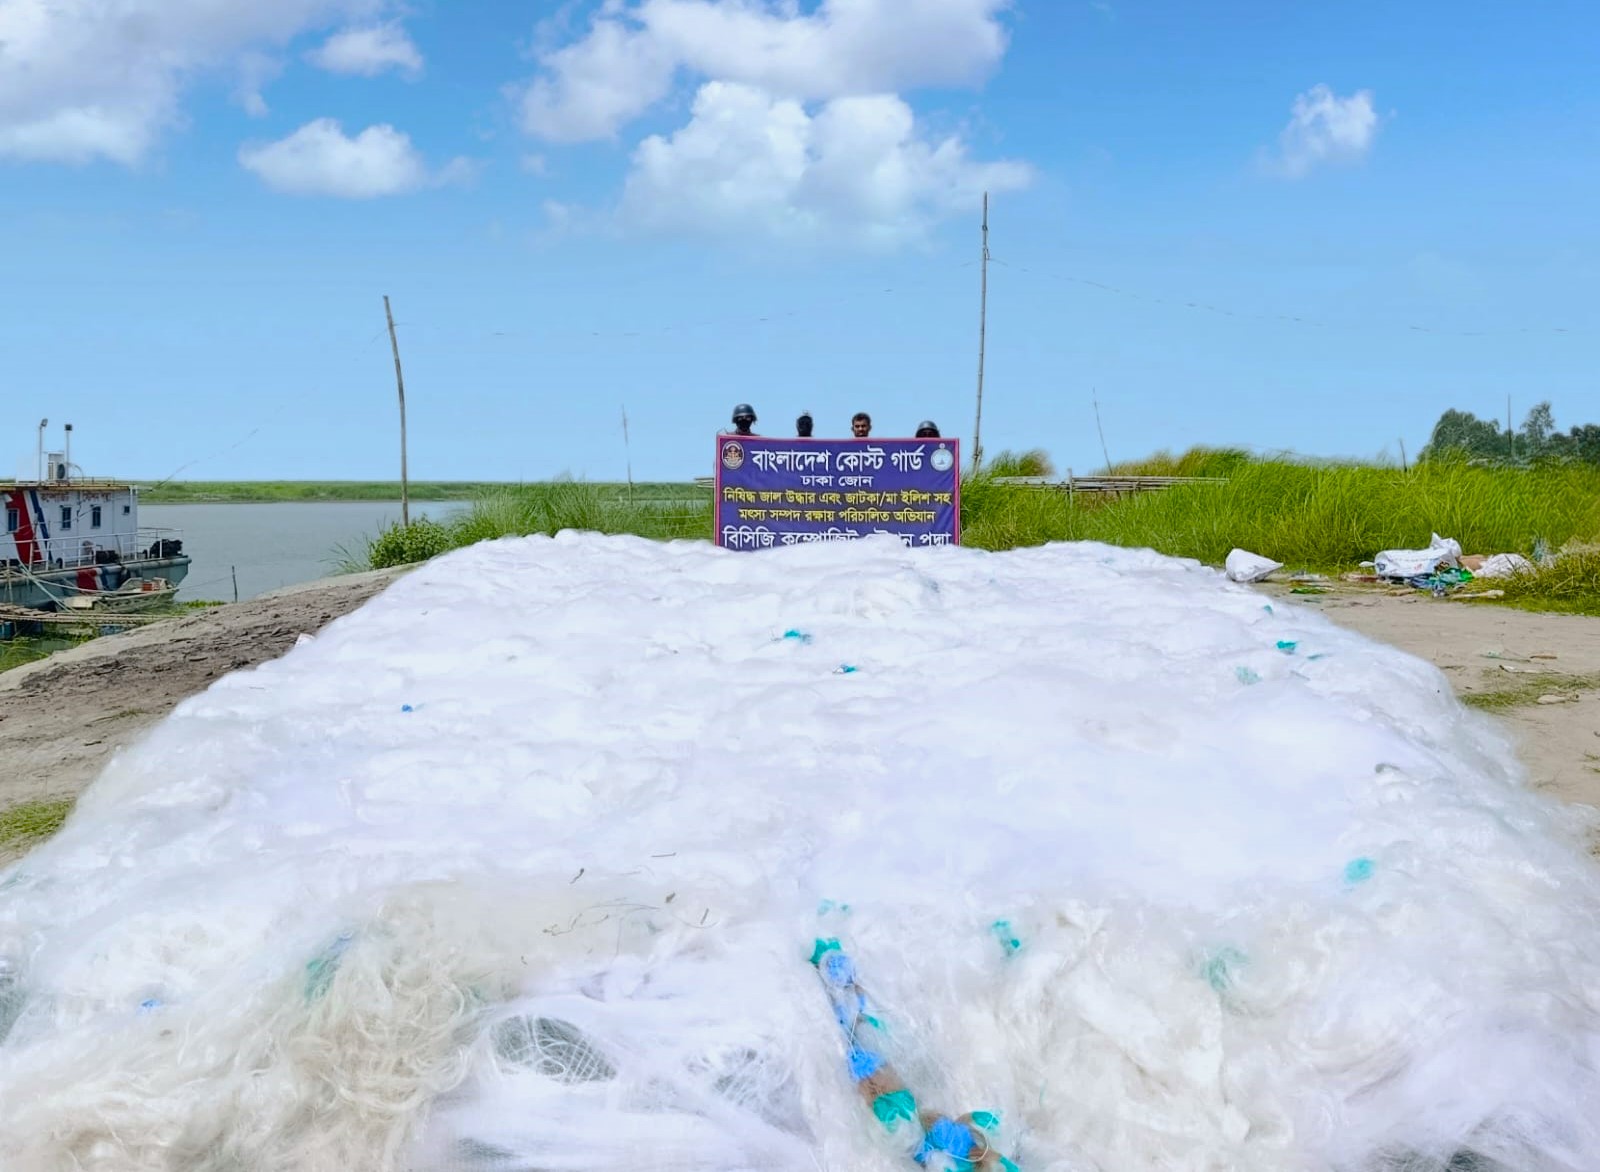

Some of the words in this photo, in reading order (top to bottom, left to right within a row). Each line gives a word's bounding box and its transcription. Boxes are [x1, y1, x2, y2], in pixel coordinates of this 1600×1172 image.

[751, 449, 831, 472] বাংলাদেশ
[835, 444, 886, 472] কোস্ট
[891, 444, 925, 472] গার্ড
[800, 475, 834, 487] ঢাকা
[838, 475, 873, 487] জোন
[723, 487, 756, 503] নিষিদ্ধ
[758, 491, 783, 504] জাল
[786, 489, 816, 504] উদ্ধার
[819, 492, 842, 505] এবং
[900, 489, 931, 505] ইলিশ
[933, 492, 952, 505] সহ
[738, 509, 767, 521] মৎস্য
[769, 509, 802, 521] সম্পদ
[804, 509, 836, 522] রক্ষায়
[838, 507, 891, 523] পরিচালিত
[893, 507, 936, 523] অভিযান
[721, 525, 776, 548] বিসিজি
